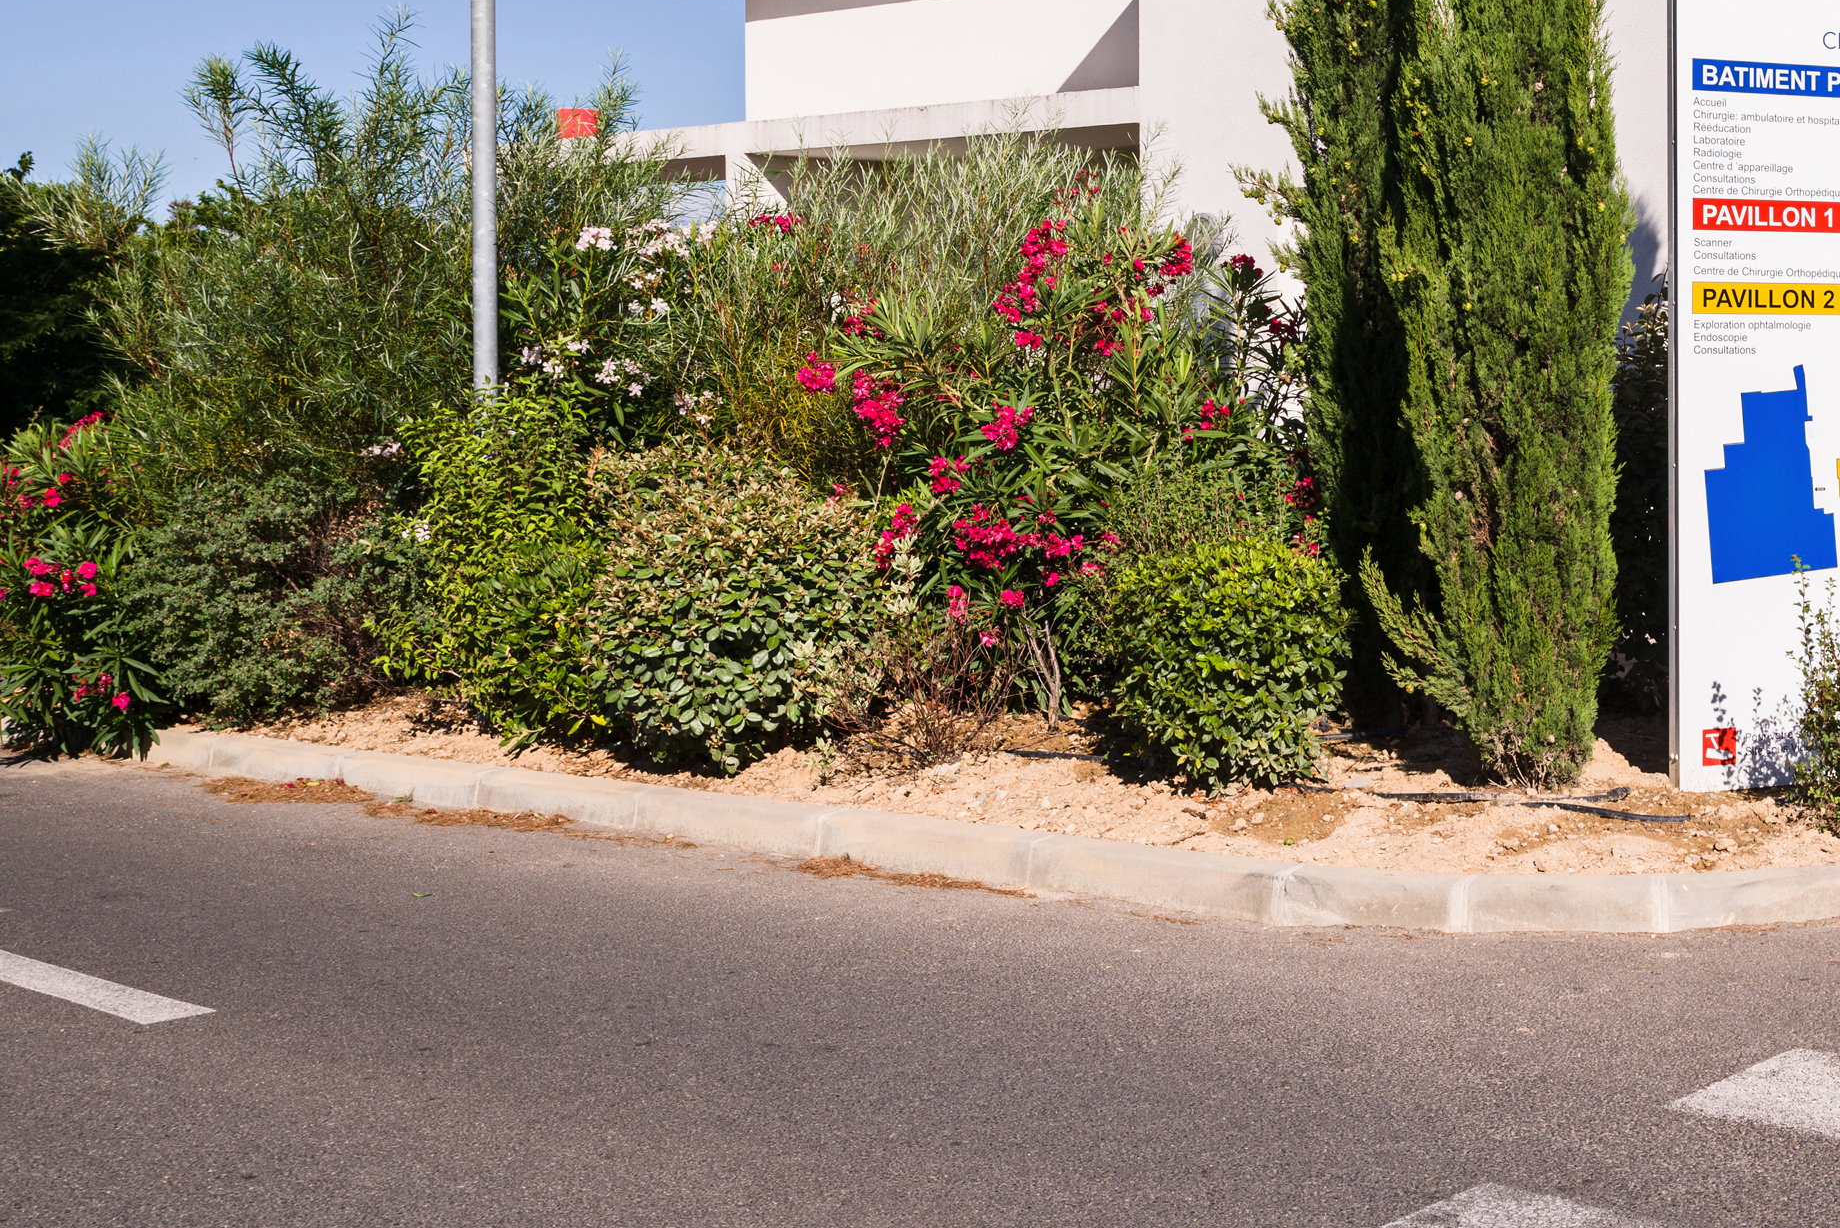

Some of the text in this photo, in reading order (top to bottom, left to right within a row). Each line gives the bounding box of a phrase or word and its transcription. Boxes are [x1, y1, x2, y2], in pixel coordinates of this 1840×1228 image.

[1702, 64, 1821, 92] BATIMENT
[1693, 97, 1726, 107] Accueil
[1694, 110, 1737, 121] Chirurgie:
[1741, 113, 1793, 123] ambulatoire
[1694, 122, 1751, 133] Rééducation
[1694, 135, 1745, 146] Laboratoire
[1694, 148, 1742, 160] Radiologie
[1693, 160, 1724, 170] Centre
[1693, 173, 1755, 184] Consultations
[1693, 185, 1724, 194] Centre
[1727, 185, 1739, 195] de
[1741, 186, 1782, 198] Chirurgie
[1703, 205, 1832, 227] PAVILLON 1
[1694, 238, 1732, 247] Scanner
[1694, 250, 1756, 260] Consultations
[1694, 266, 1724, 275] Centre
[1728, 266, 1740, 275] de
[1742, 267, 1783, 279] Chirurgie
[1704, 289, 1834, 308] PAVILLON 2
[1694, 320, 1811, 331] Exploration ophtalmologie
[1694, 333, 1747, 343] Endoscopie
[1694, 345, 1756, 354] Consultations
